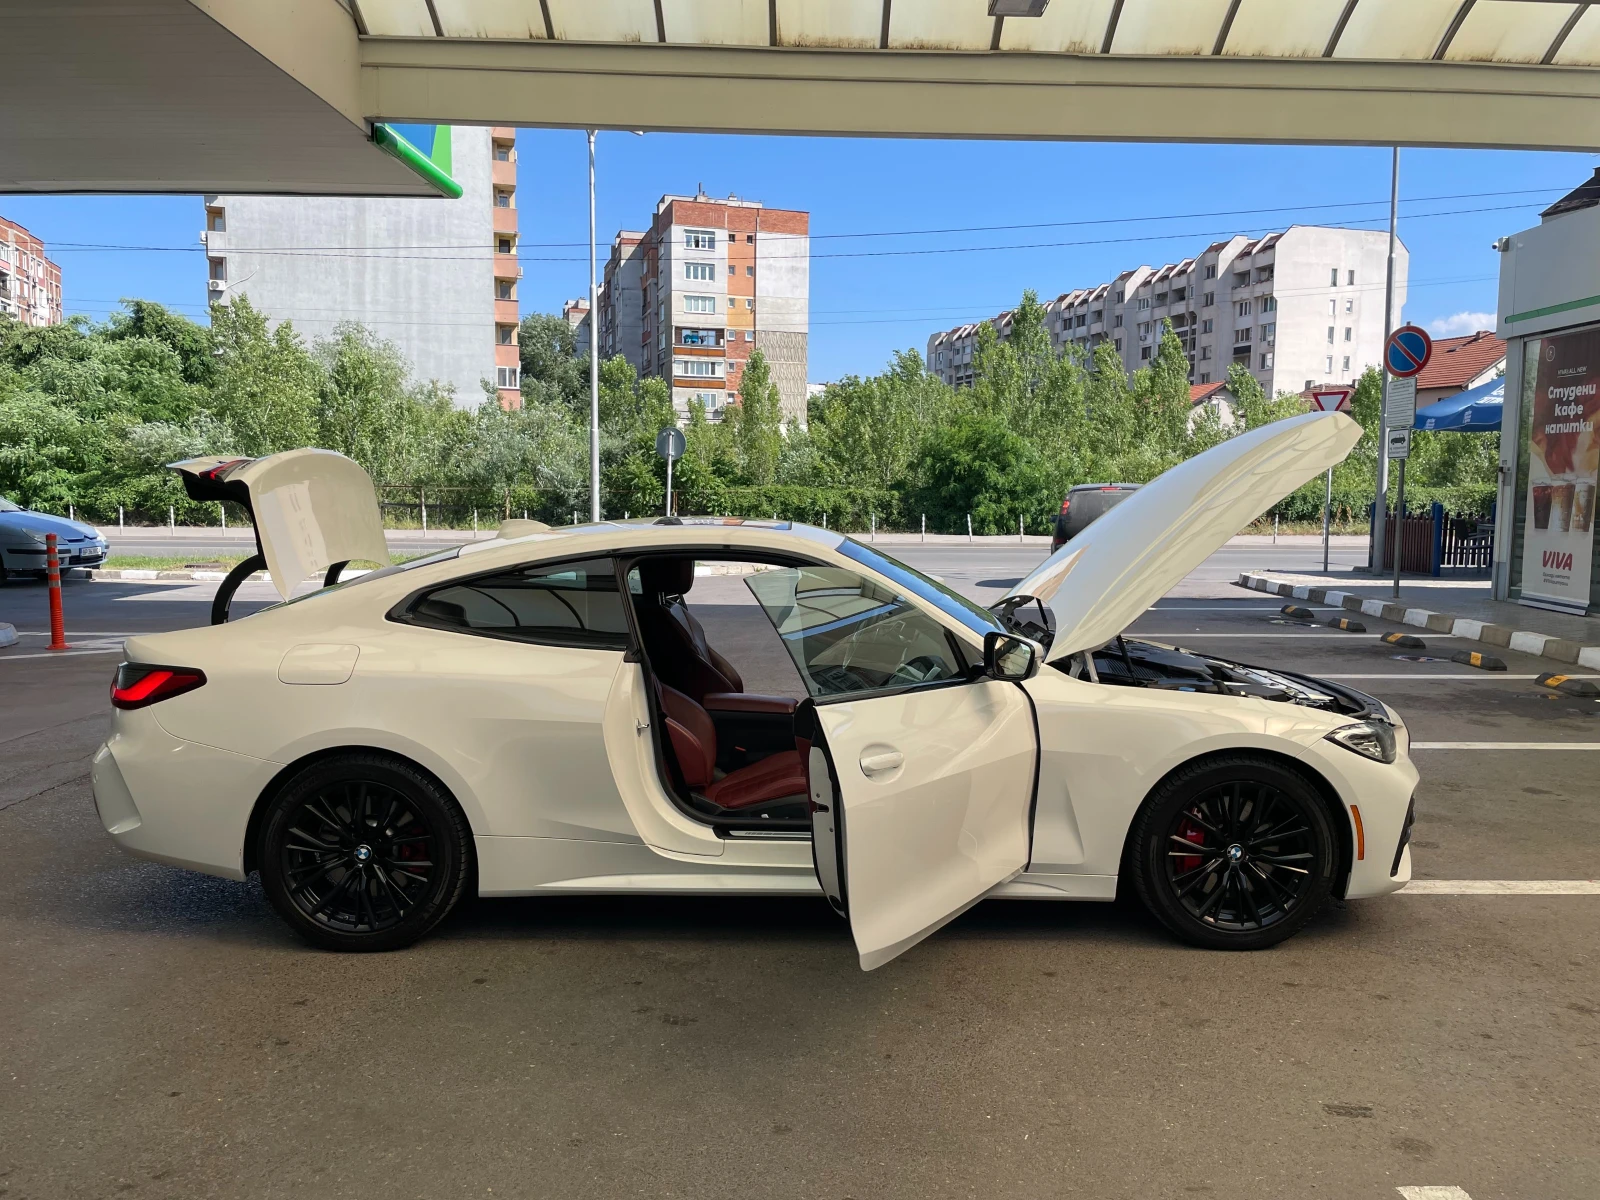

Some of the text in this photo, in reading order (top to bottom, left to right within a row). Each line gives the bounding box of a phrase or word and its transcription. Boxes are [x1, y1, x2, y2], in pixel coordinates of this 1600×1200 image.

[1548, 383, 1597, 401] Студени
[1554, 402, 1584, 419] кафе
[1545, 418, 1594, 435] напитки
[1542, 550, 1573, 571] VIVA
